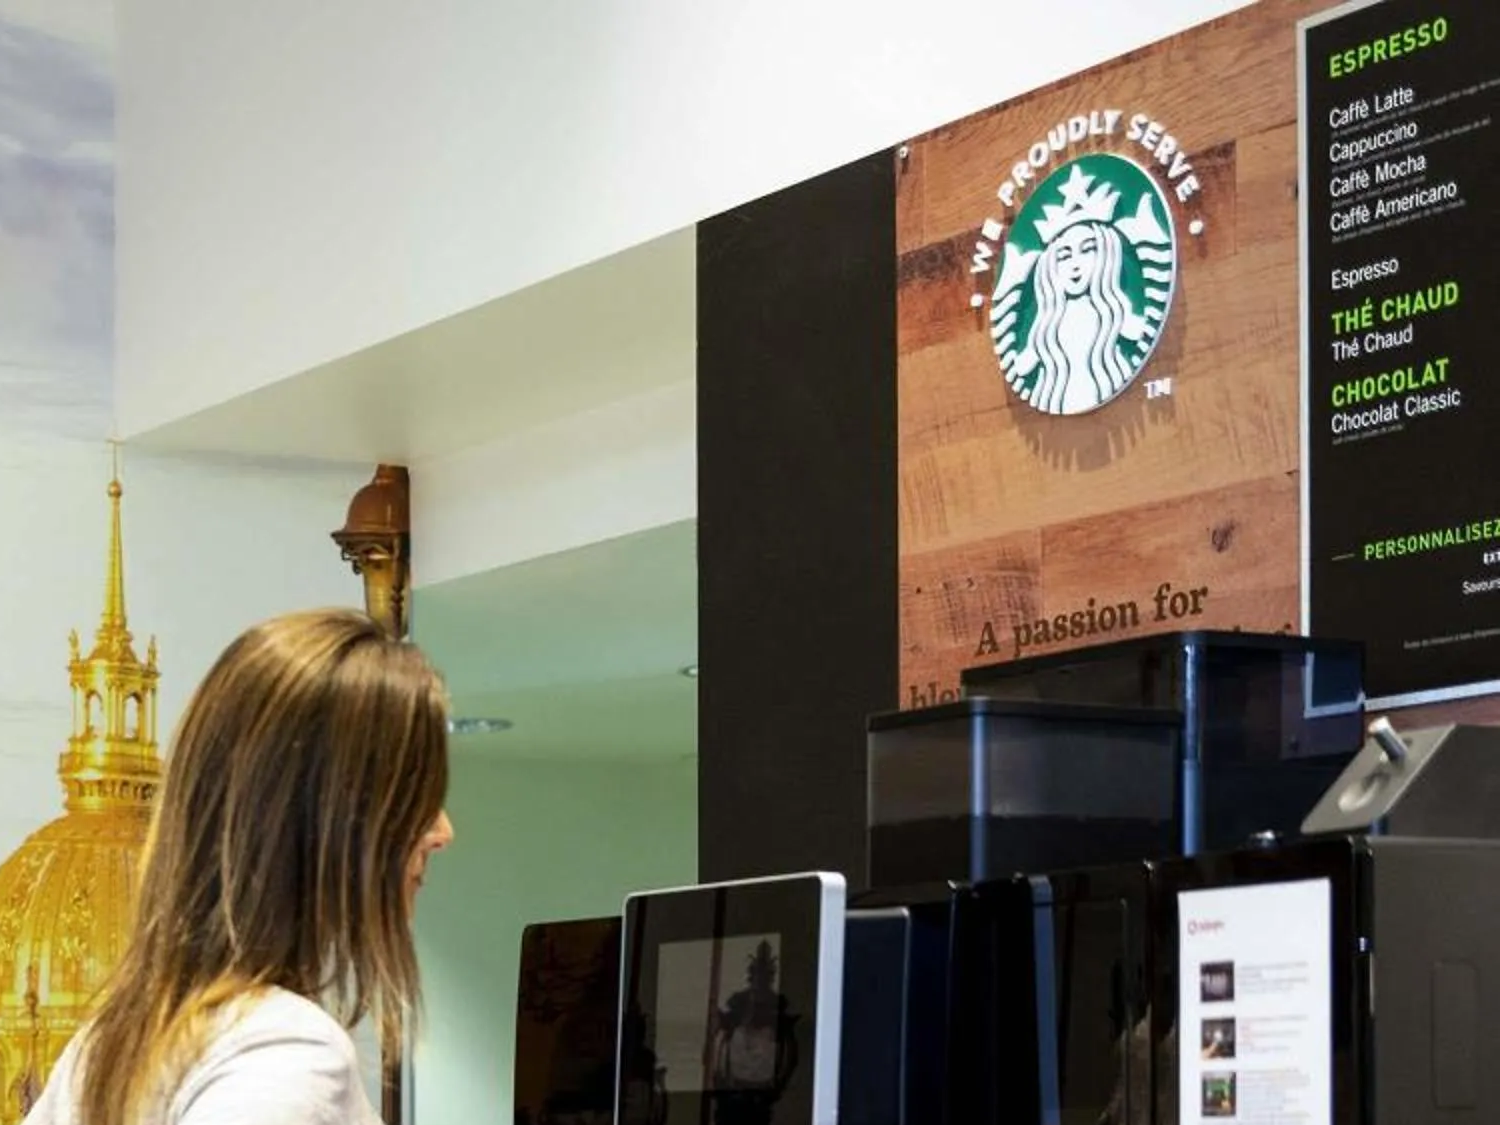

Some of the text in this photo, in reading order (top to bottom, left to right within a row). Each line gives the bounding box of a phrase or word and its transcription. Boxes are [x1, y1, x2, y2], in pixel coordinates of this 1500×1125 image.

[1329, 17, 1447, 78] ESPRESSO
[1329, 97, 1369, 128] Caffè
[1375, 87, 1413, 113] Latte
[1329, 122, 1417, 163] Cappuccino
[970, 109, 1199, 274] WE PROUDLY SERVE
[1329, 169, 1370, 198] Caffè
[1375, 154, 1427, 184] Mocha
[1329, 204, 1370, 232] Caffè
[1375, 181, 1457, 219] Americano
[1331, 257, 1399, 290] Espresso
[1331, 281, 1459, 335] THÉ CHAUD
[1331, 322, 1413, 361] Thé Chaud
[1143, 377, 1171, 399] TM
[1331, 358, 1449, 407] CHOCOLAT
[1331, 387, 1461, 433] Chocolat Classic
[1364, 518, 1500, 561] PERSONNALISEZ
[974, 582, 1208, 658] A passion for
